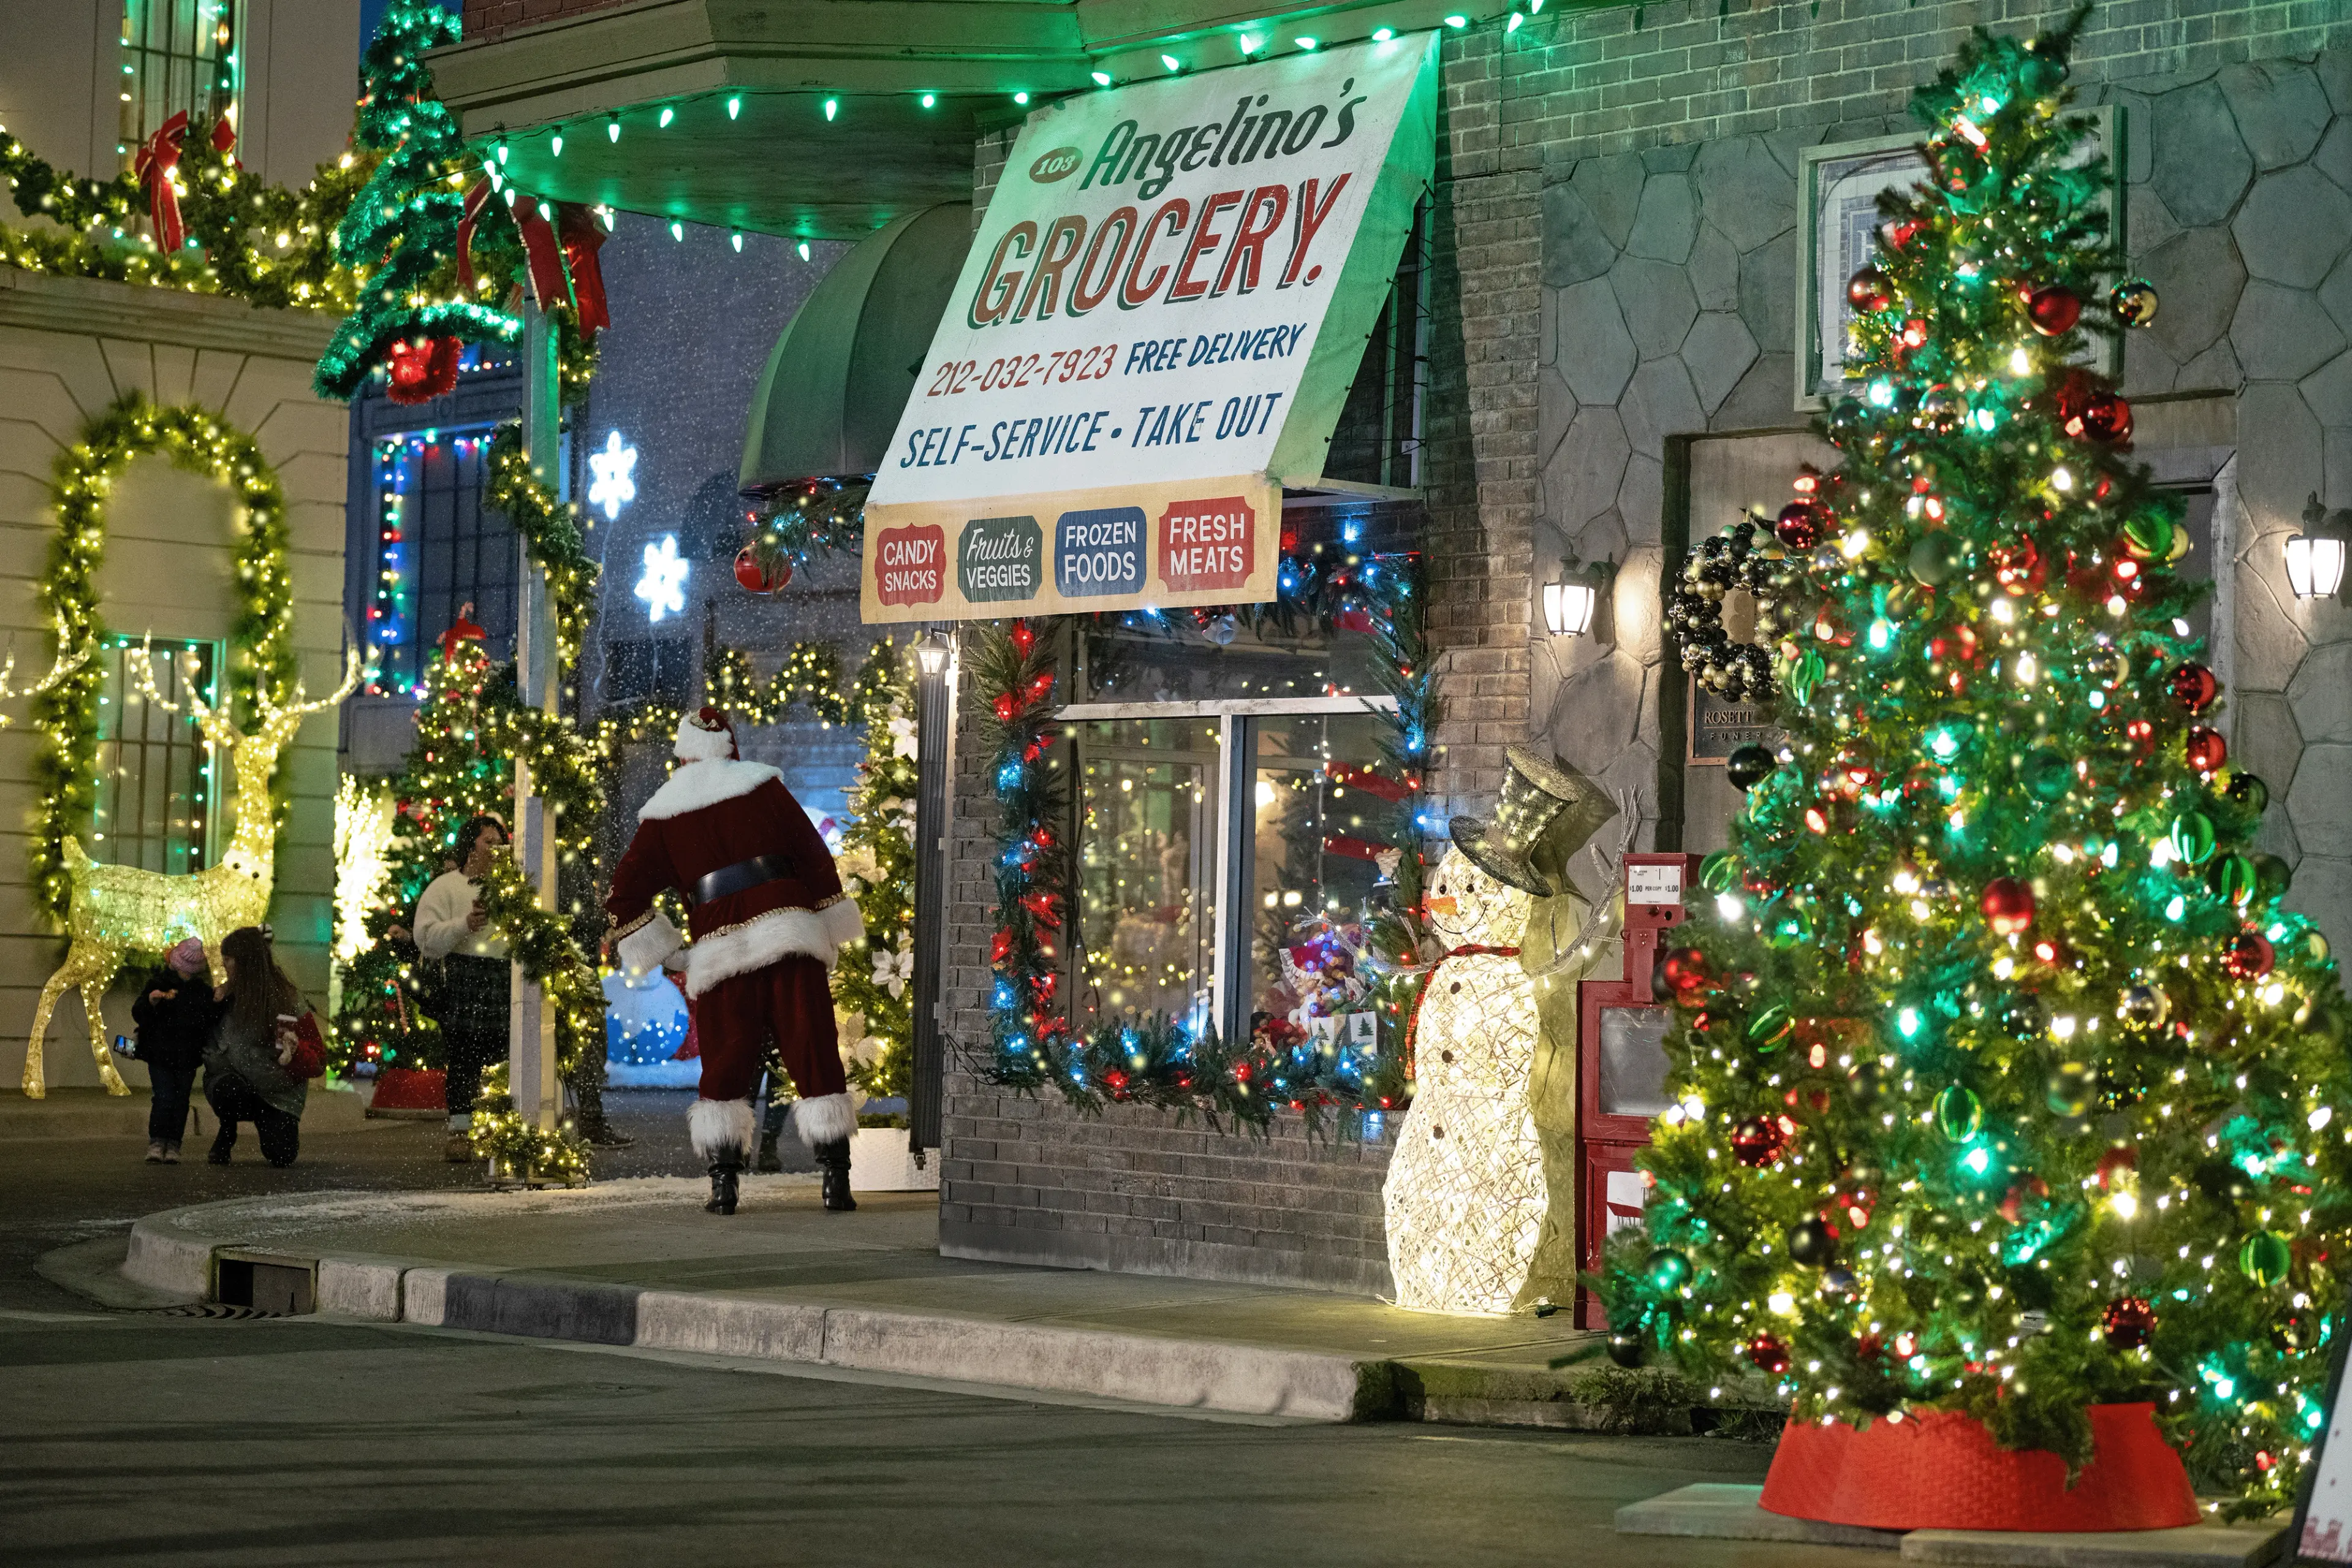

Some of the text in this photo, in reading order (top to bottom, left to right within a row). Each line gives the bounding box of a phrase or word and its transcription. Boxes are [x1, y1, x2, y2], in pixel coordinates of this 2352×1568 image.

[1037, 77, 1367, 200] 103 Angelino's
[967, 172, 1352, 330] GROCERY.
[926, 323, 1307, 397] 212-032-7923 FREE DELIVERY
[900, 393, 1283, 469] SELF-SERVICE TAKE OUT
[967, 527, 1033, 561] Fruits &
[1065, 521, 1137, 548] FROZEN
[1169, 513, 1245, 544] FRESH
[884, 540, 938, 566] CANDY
[1065, 552, 1136, 584] FOODS
[1170, 545, 1244, 576] MEATS
[884, 570, 937, 591] SNACKS
[966, 564, 1031, 588] VEGGIES
[1705, 710, 1754, 725] ROSETT
